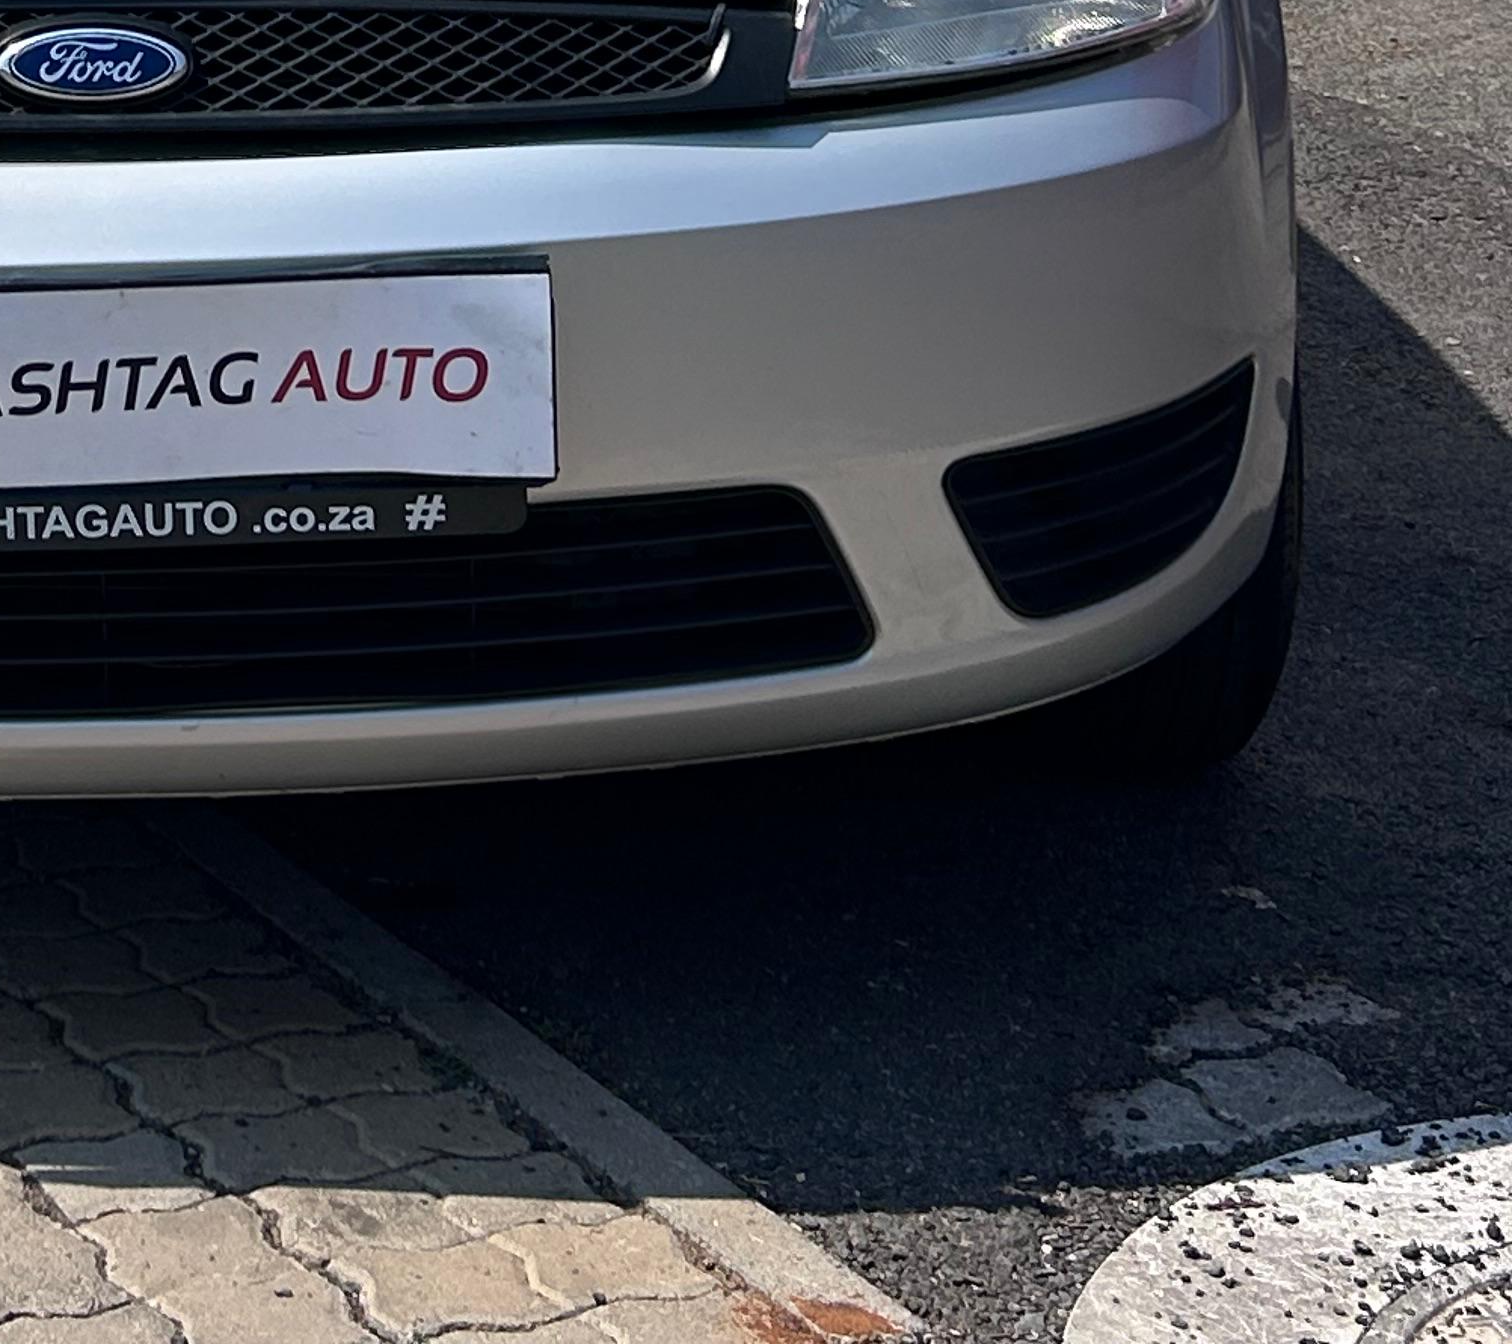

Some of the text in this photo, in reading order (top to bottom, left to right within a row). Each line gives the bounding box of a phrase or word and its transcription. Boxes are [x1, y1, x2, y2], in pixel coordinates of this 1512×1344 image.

[39, 41, 144, 82] Ford
[271, 348, 488, 404] AUTO
[252, 505, 376, 534] .co.za
